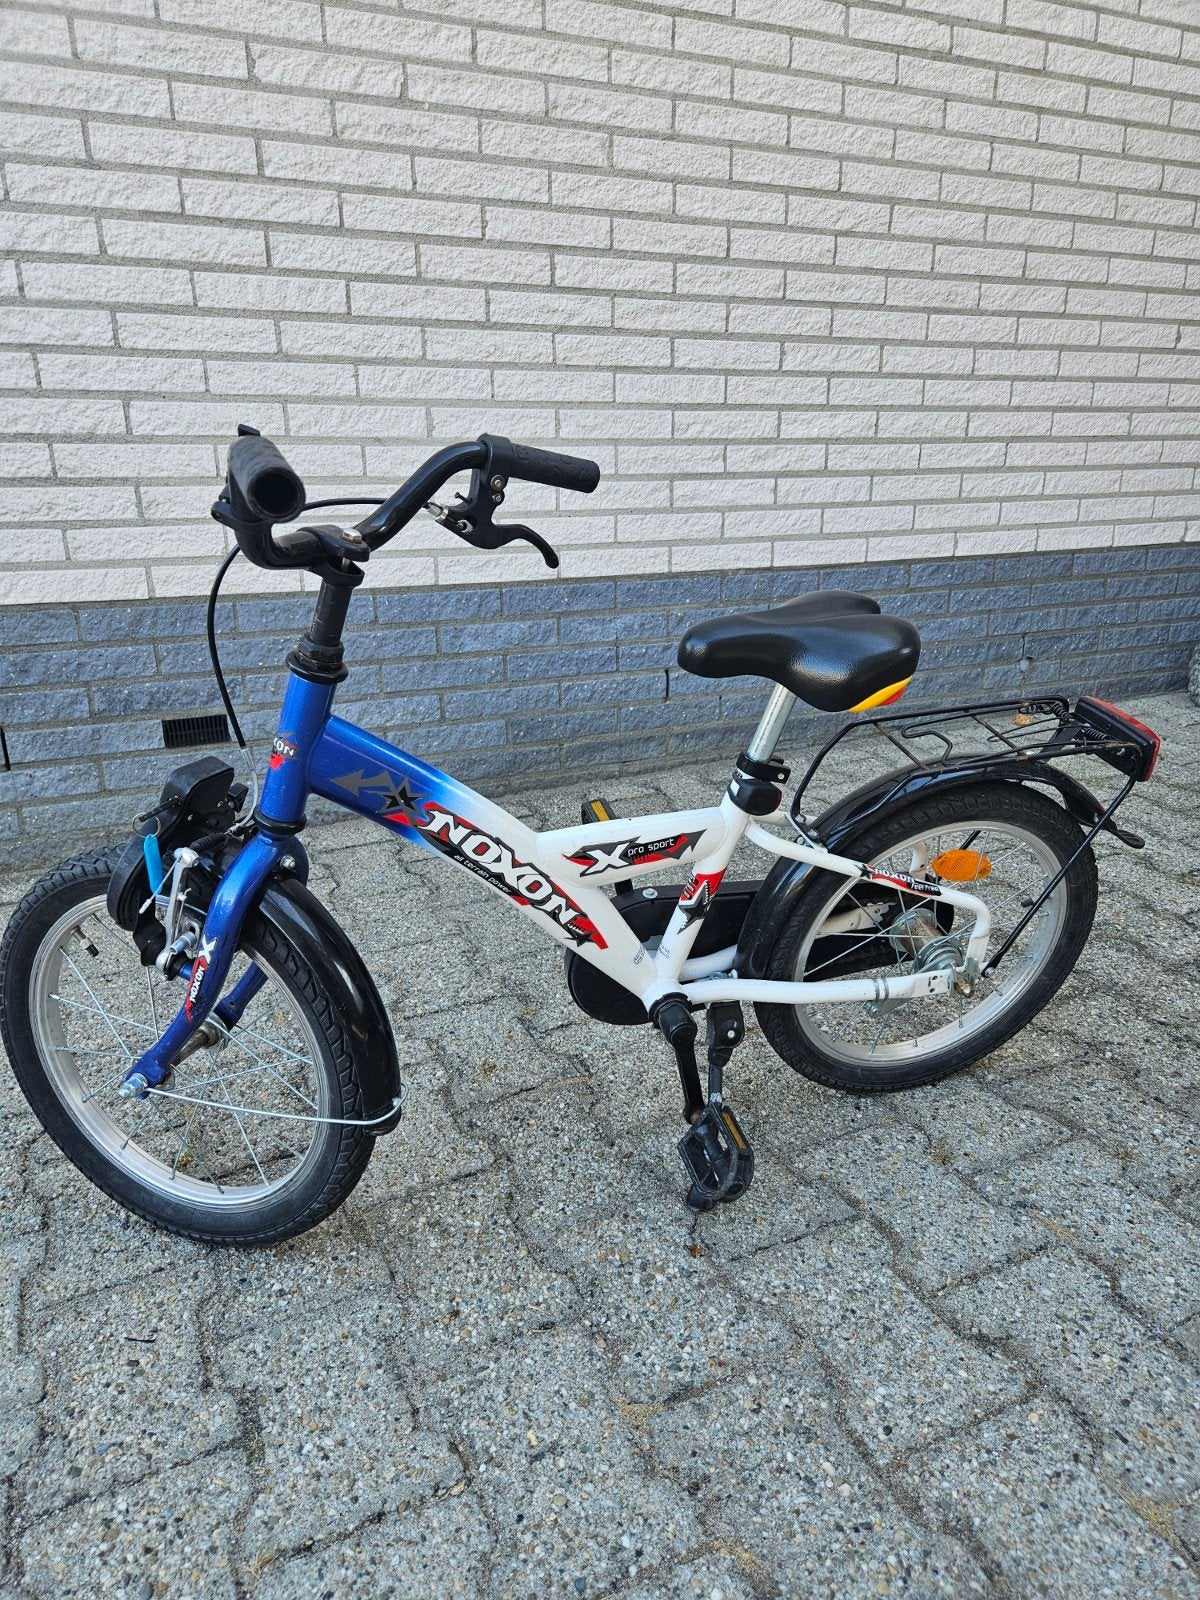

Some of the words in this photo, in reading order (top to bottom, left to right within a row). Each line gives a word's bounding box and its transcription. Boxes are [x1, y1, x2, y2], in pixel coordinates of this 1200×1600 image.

[627, 846, 645, 857] pro
[647, 838, 675, 853] sport
[417, 810, 580, 925] NOXON
[463, 860, 490, 879] terrain
[487, 877, 512, 893] power
